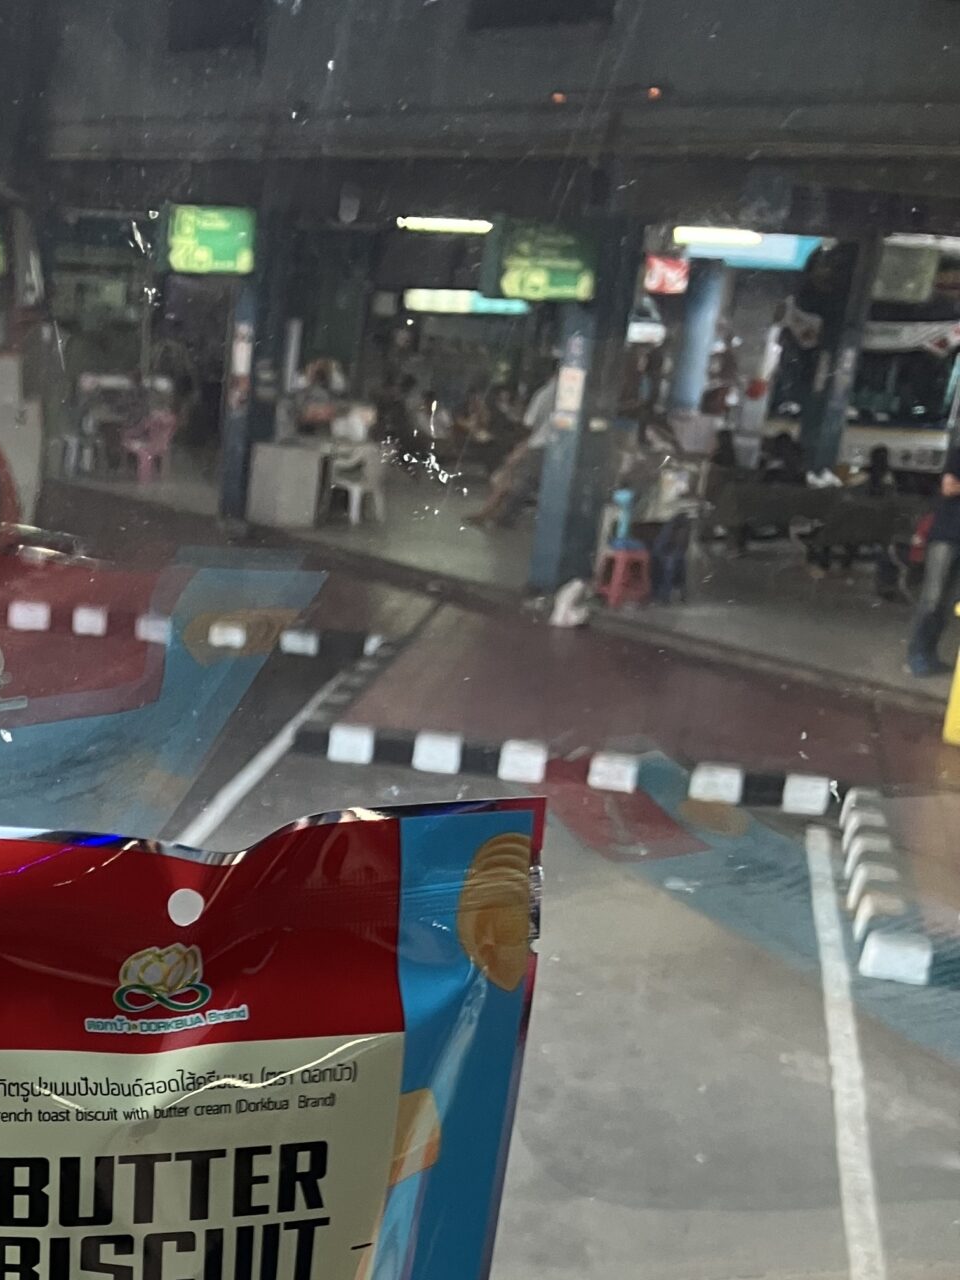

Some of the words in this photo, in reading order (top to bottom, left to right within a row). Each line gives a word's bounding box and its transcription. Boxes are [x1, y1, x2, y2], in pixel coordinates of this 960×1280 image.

[140, 1015, 204, 1032] DORKBUA
[207, 1007, 247, 1022] Brand
[38, 1109, 71, 1122] toast
[75, 1107, 118, 1122] biscuit
[122, 1107, 150, 1121] with
[153, 1105, 190, 1119] butter
[193, 1102, 232, 1116] cream
[235, 1098, 289, 1114] (Dorkbua
[297, 1092, 336, 1109] Brand)
